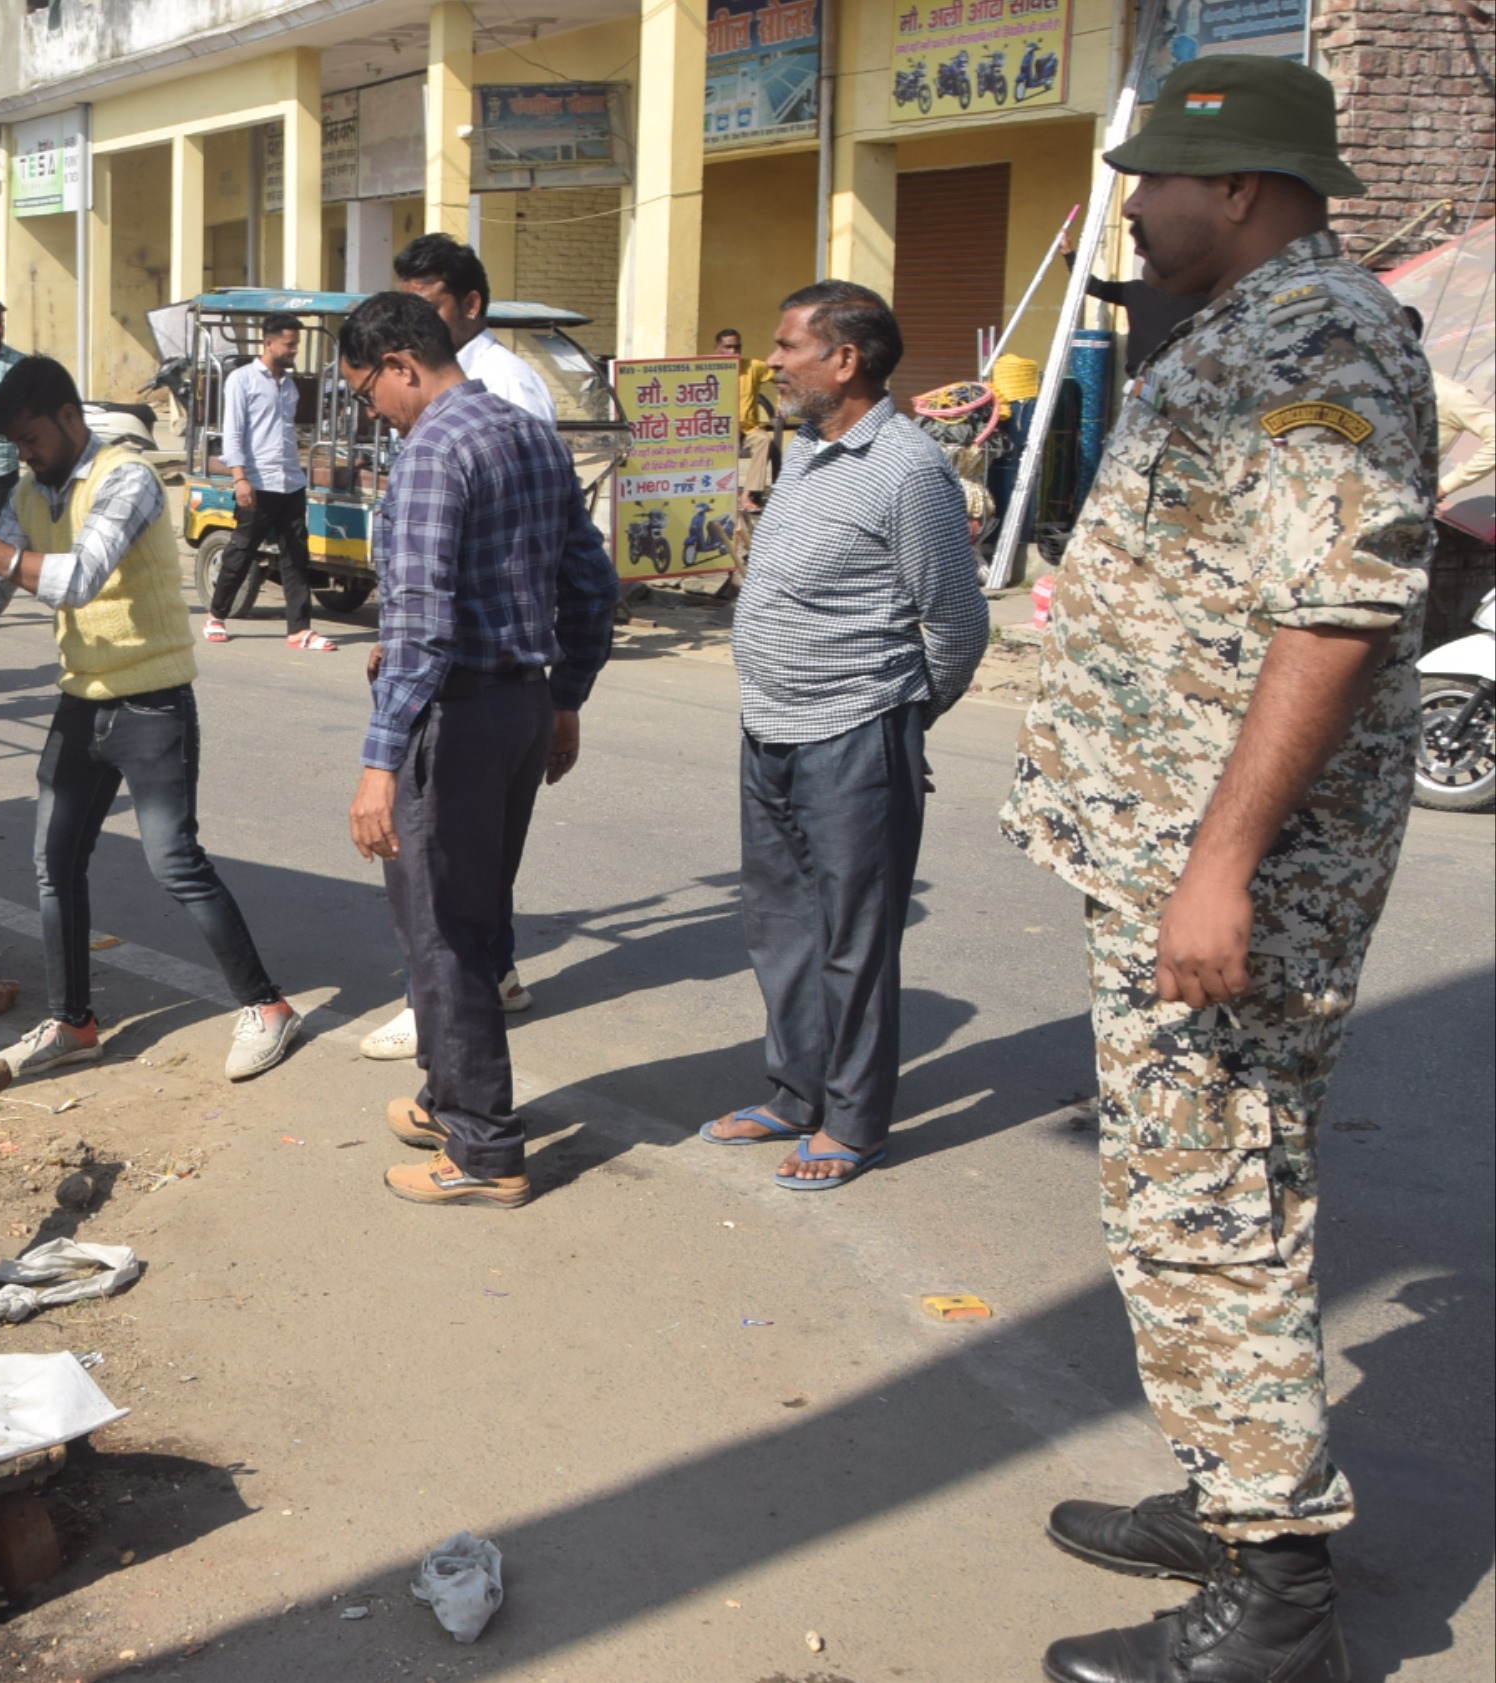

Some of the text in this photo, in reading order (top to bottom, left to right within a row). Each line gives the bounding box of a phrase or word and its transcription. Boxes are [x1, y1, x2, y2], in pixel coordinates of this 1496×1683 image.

[706, 0, 817, 57] शील सोलर
[928, 0, 963, 30] अली
[635, 373, 721, 407] मौ. अली
[627, 408, 732, 441] ऑटो सर्विस
[1268, 405, 1367, 435] ENFORCEMENT TASK FORCE
[673, 482, 695, 494] TVS
